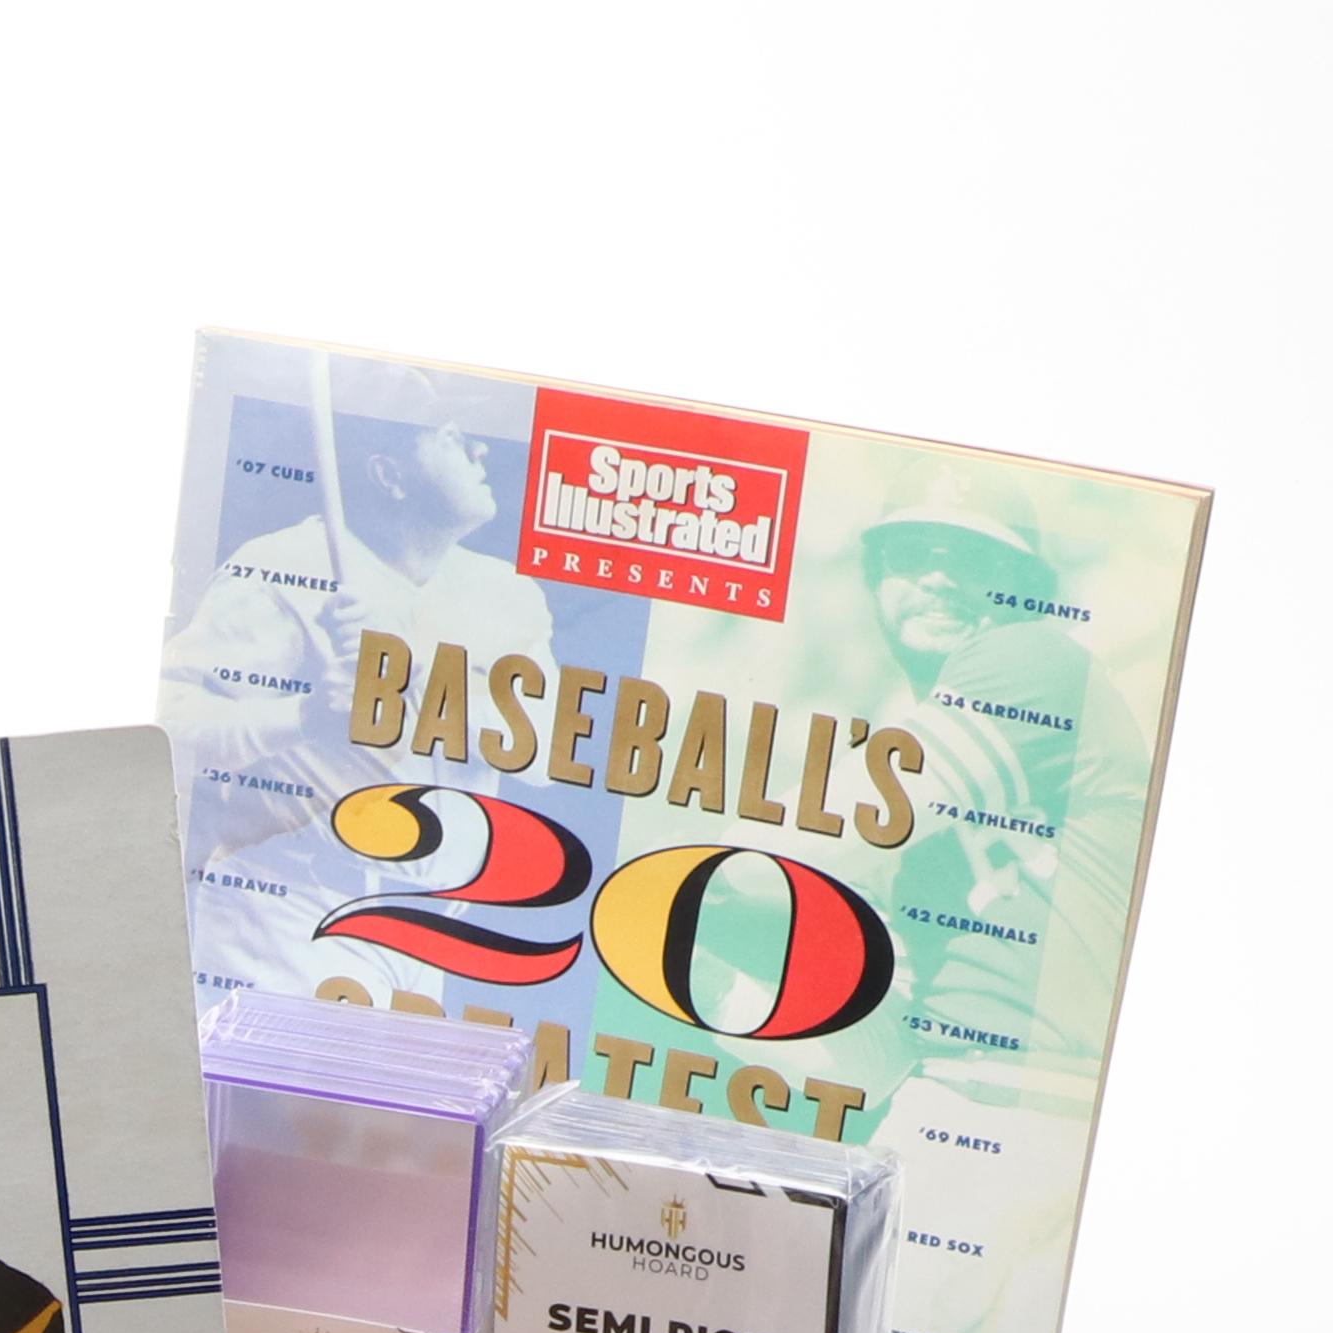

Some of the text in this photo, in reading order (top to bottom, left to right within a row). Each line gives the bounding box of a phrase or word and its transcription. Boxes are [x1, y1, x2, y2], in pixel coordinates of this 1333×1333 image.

[271, 464, 316, 484] CUBS
[589, 445, 737, 513] Sports
[543, 472, 774, 563] Illustrated
[259, 567, 339, 593] YANKEES
[533, 548, 772, 608] PRESENTS
[1023, 597, 1091, 622] GIANTS
[248, 672, 312, 695] GIANTS
[971, 699, 1073, 732] CARDINALS
[349, 629, 924, 849] BASEBALL'S
[237, 773, 315, 799] YANKEES
[964, 810, 1056, 839] ATHLETICS
[222, 873, 288, 897] BRAVES
[313, 784, 895, 1040] 20
[936, 913, 1038, 945] CARDINALS
[939, 1022, 1020, 1051] YANKEES
[955, 1133, 1002, 1155] METS
[591, 1232, 745, 1271] HUMONGOUS
[907, 1231, 984, 1257] RED SOX
[632, 1256, 709, 1282] HOARD
